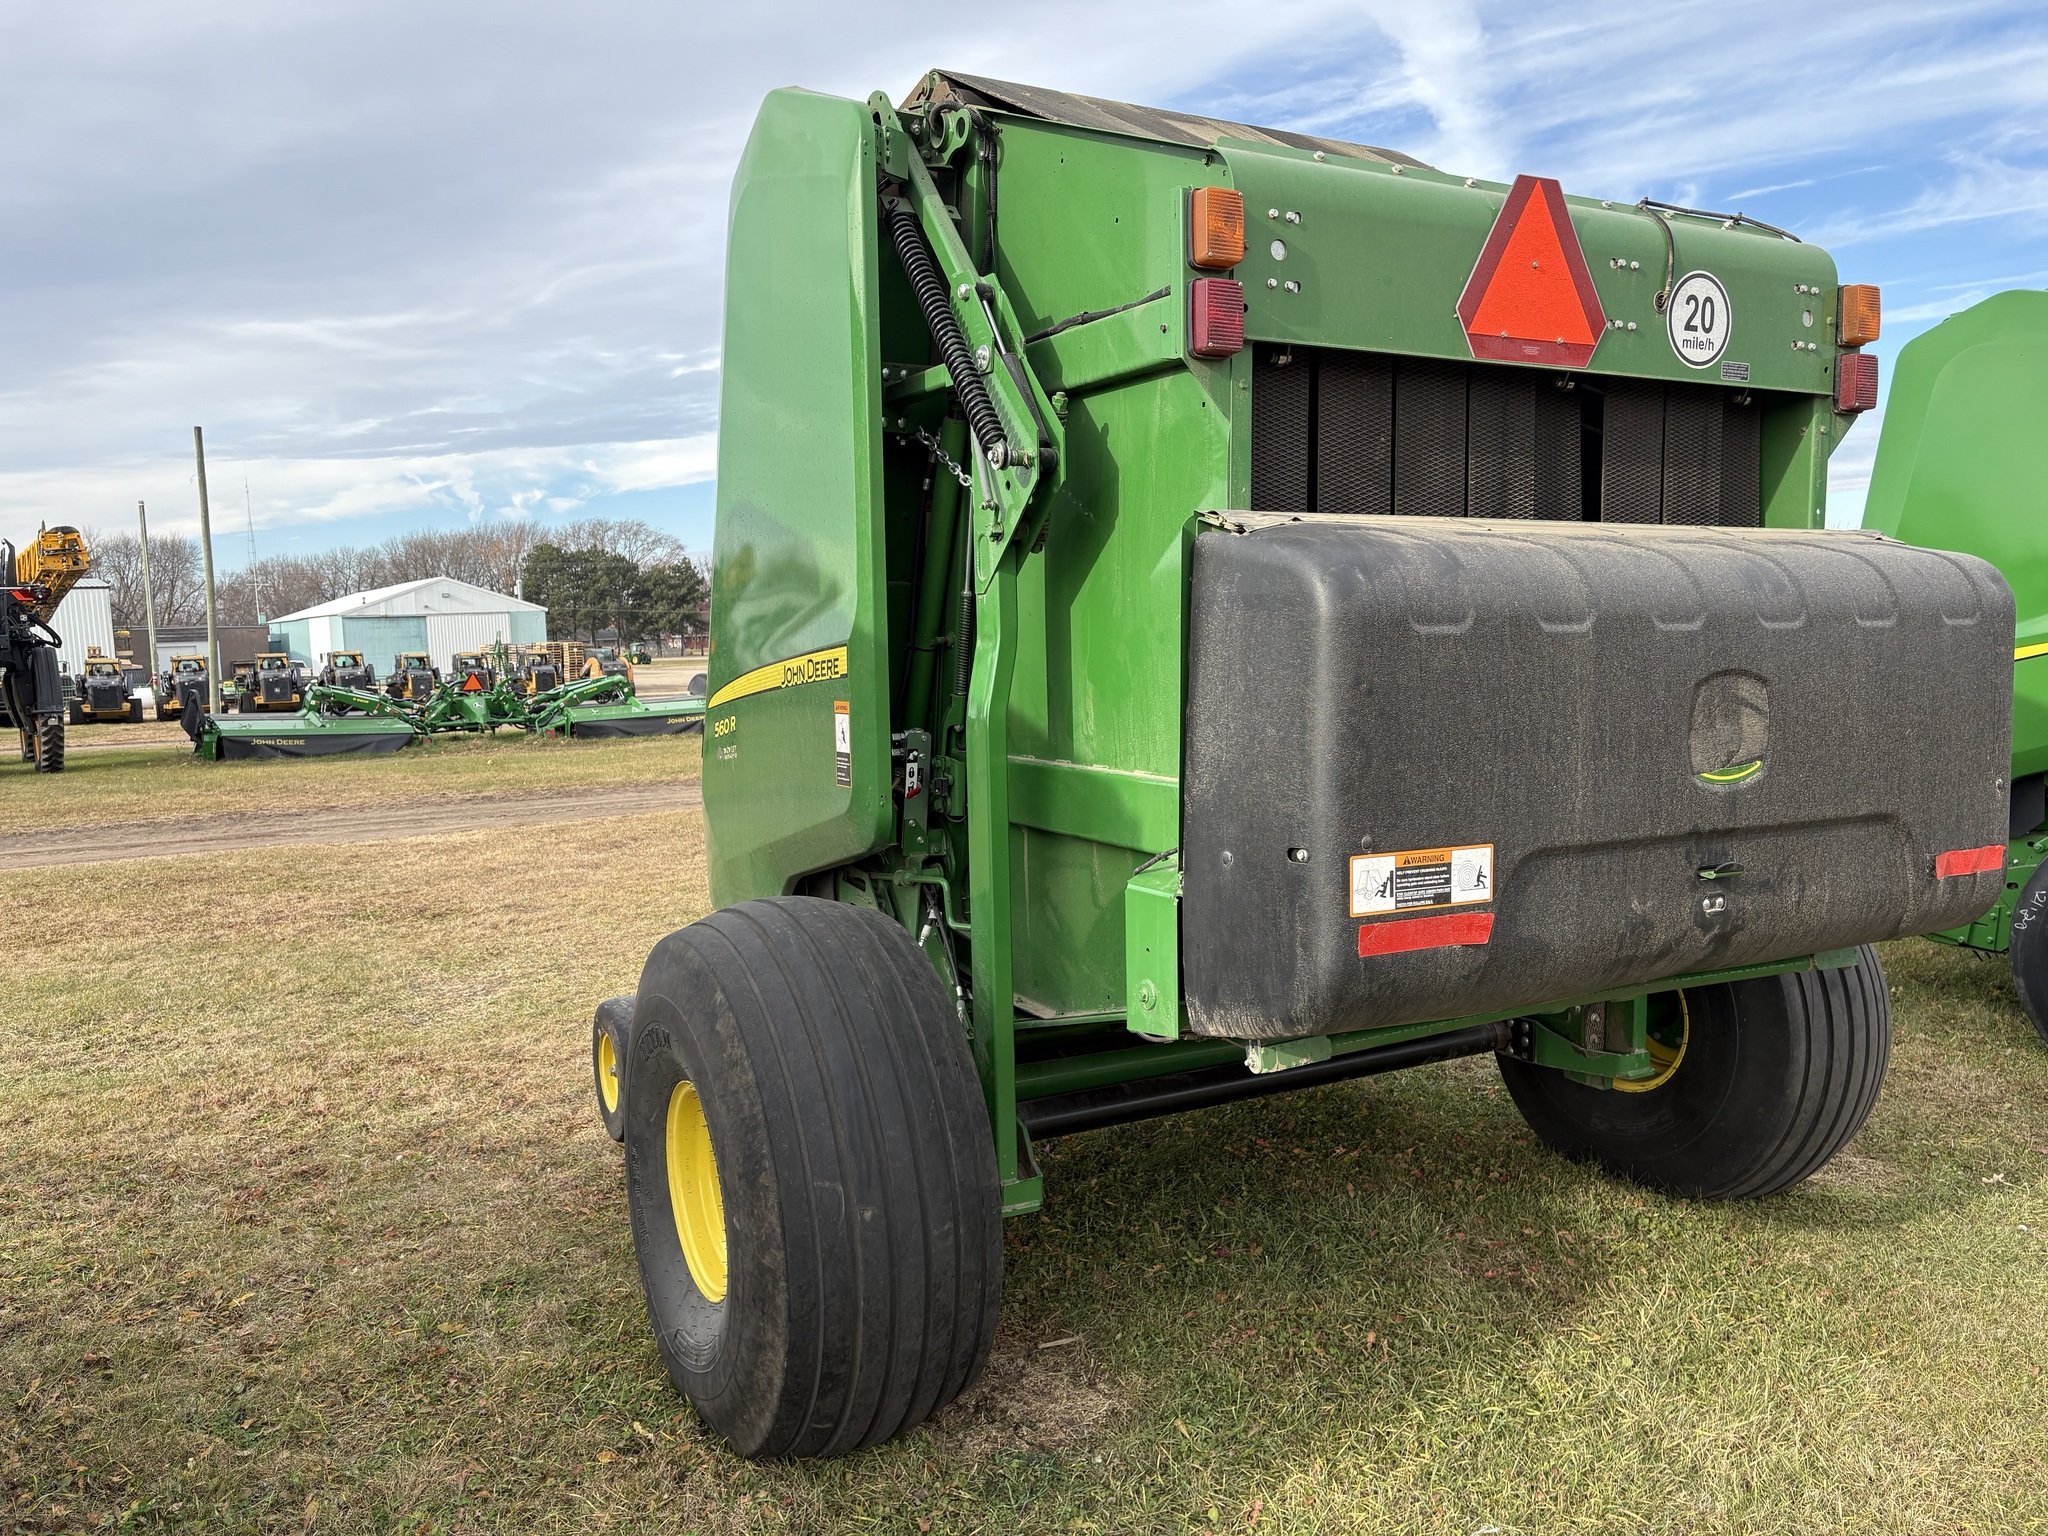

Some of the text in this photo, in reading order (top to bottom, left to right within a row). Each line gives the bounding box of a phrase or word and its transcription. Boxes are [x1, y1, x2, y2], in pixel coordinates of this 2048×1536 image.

[1684, 294, 1715, 334] 20
[1682, 336, 1714, 351] mile/h
[781, 658, 840, 686] JOHN DEERE
[714, 718, 730, 738] 560
[276, 738, 306, 746] DEERE
[1410, 854, 1445, 864] WARNING
